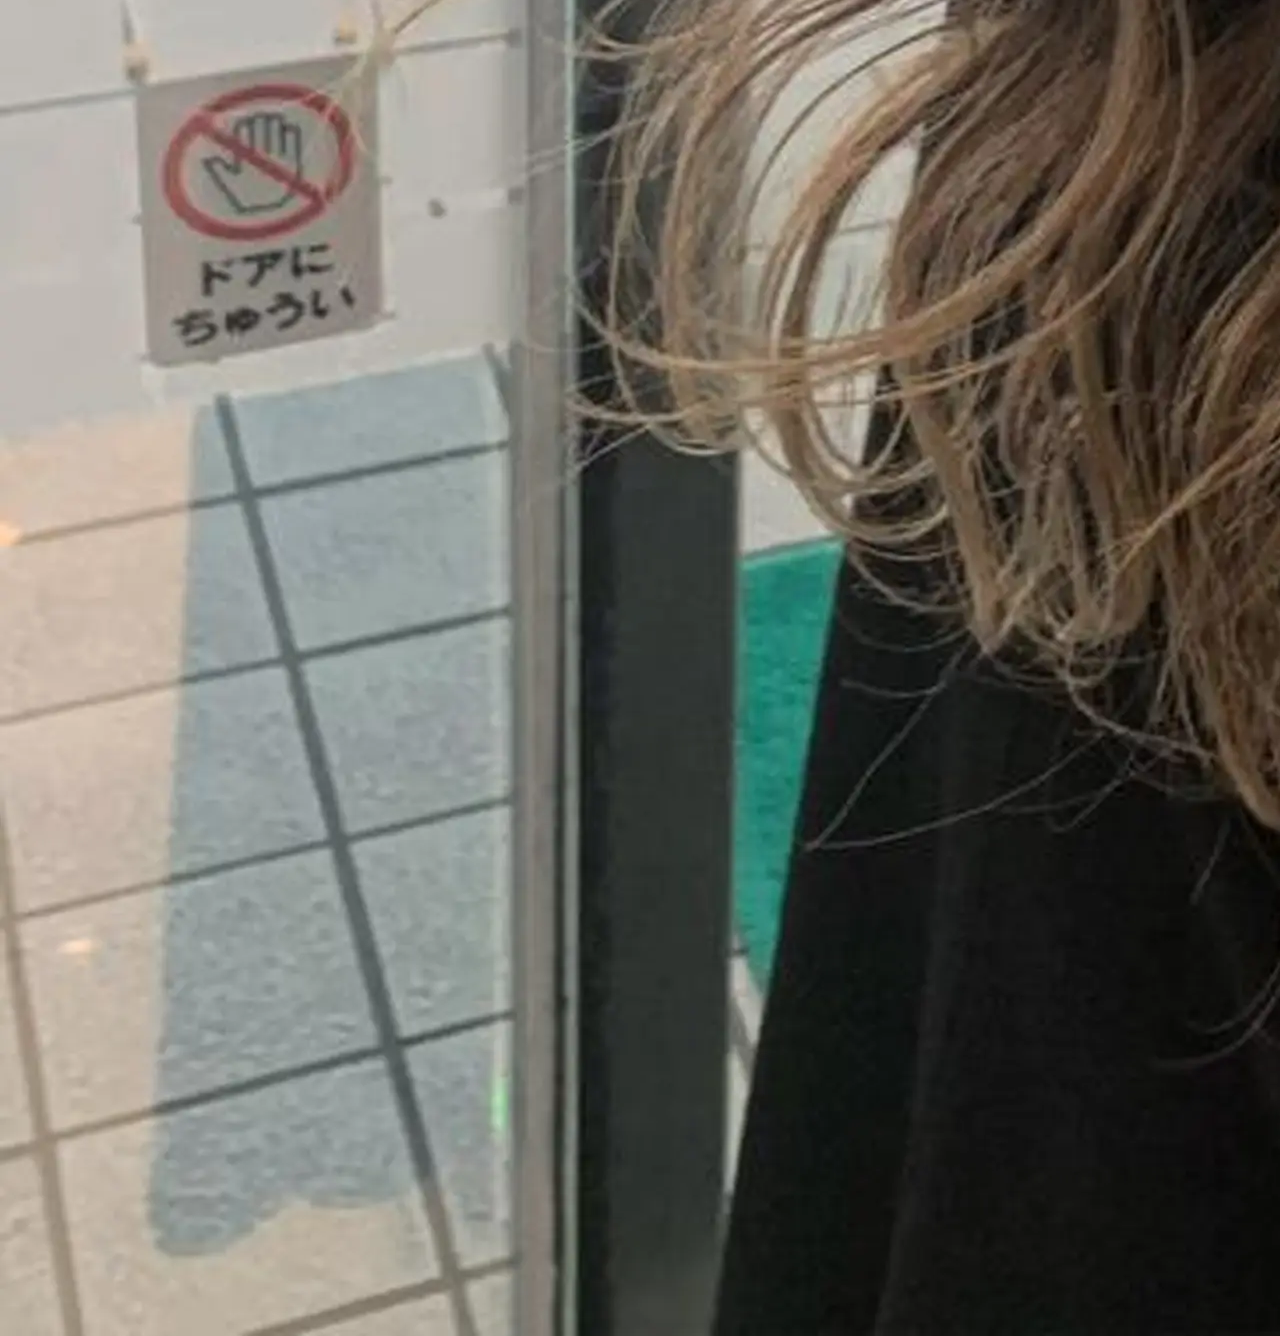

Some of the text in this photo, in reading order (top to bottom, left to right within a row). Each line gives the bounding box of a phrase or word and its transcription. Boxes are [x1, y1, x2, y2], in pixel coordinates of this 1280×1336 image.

[202, 242, 334, 298] ドアに
[173, 285, 356, 347] ちゅうい
